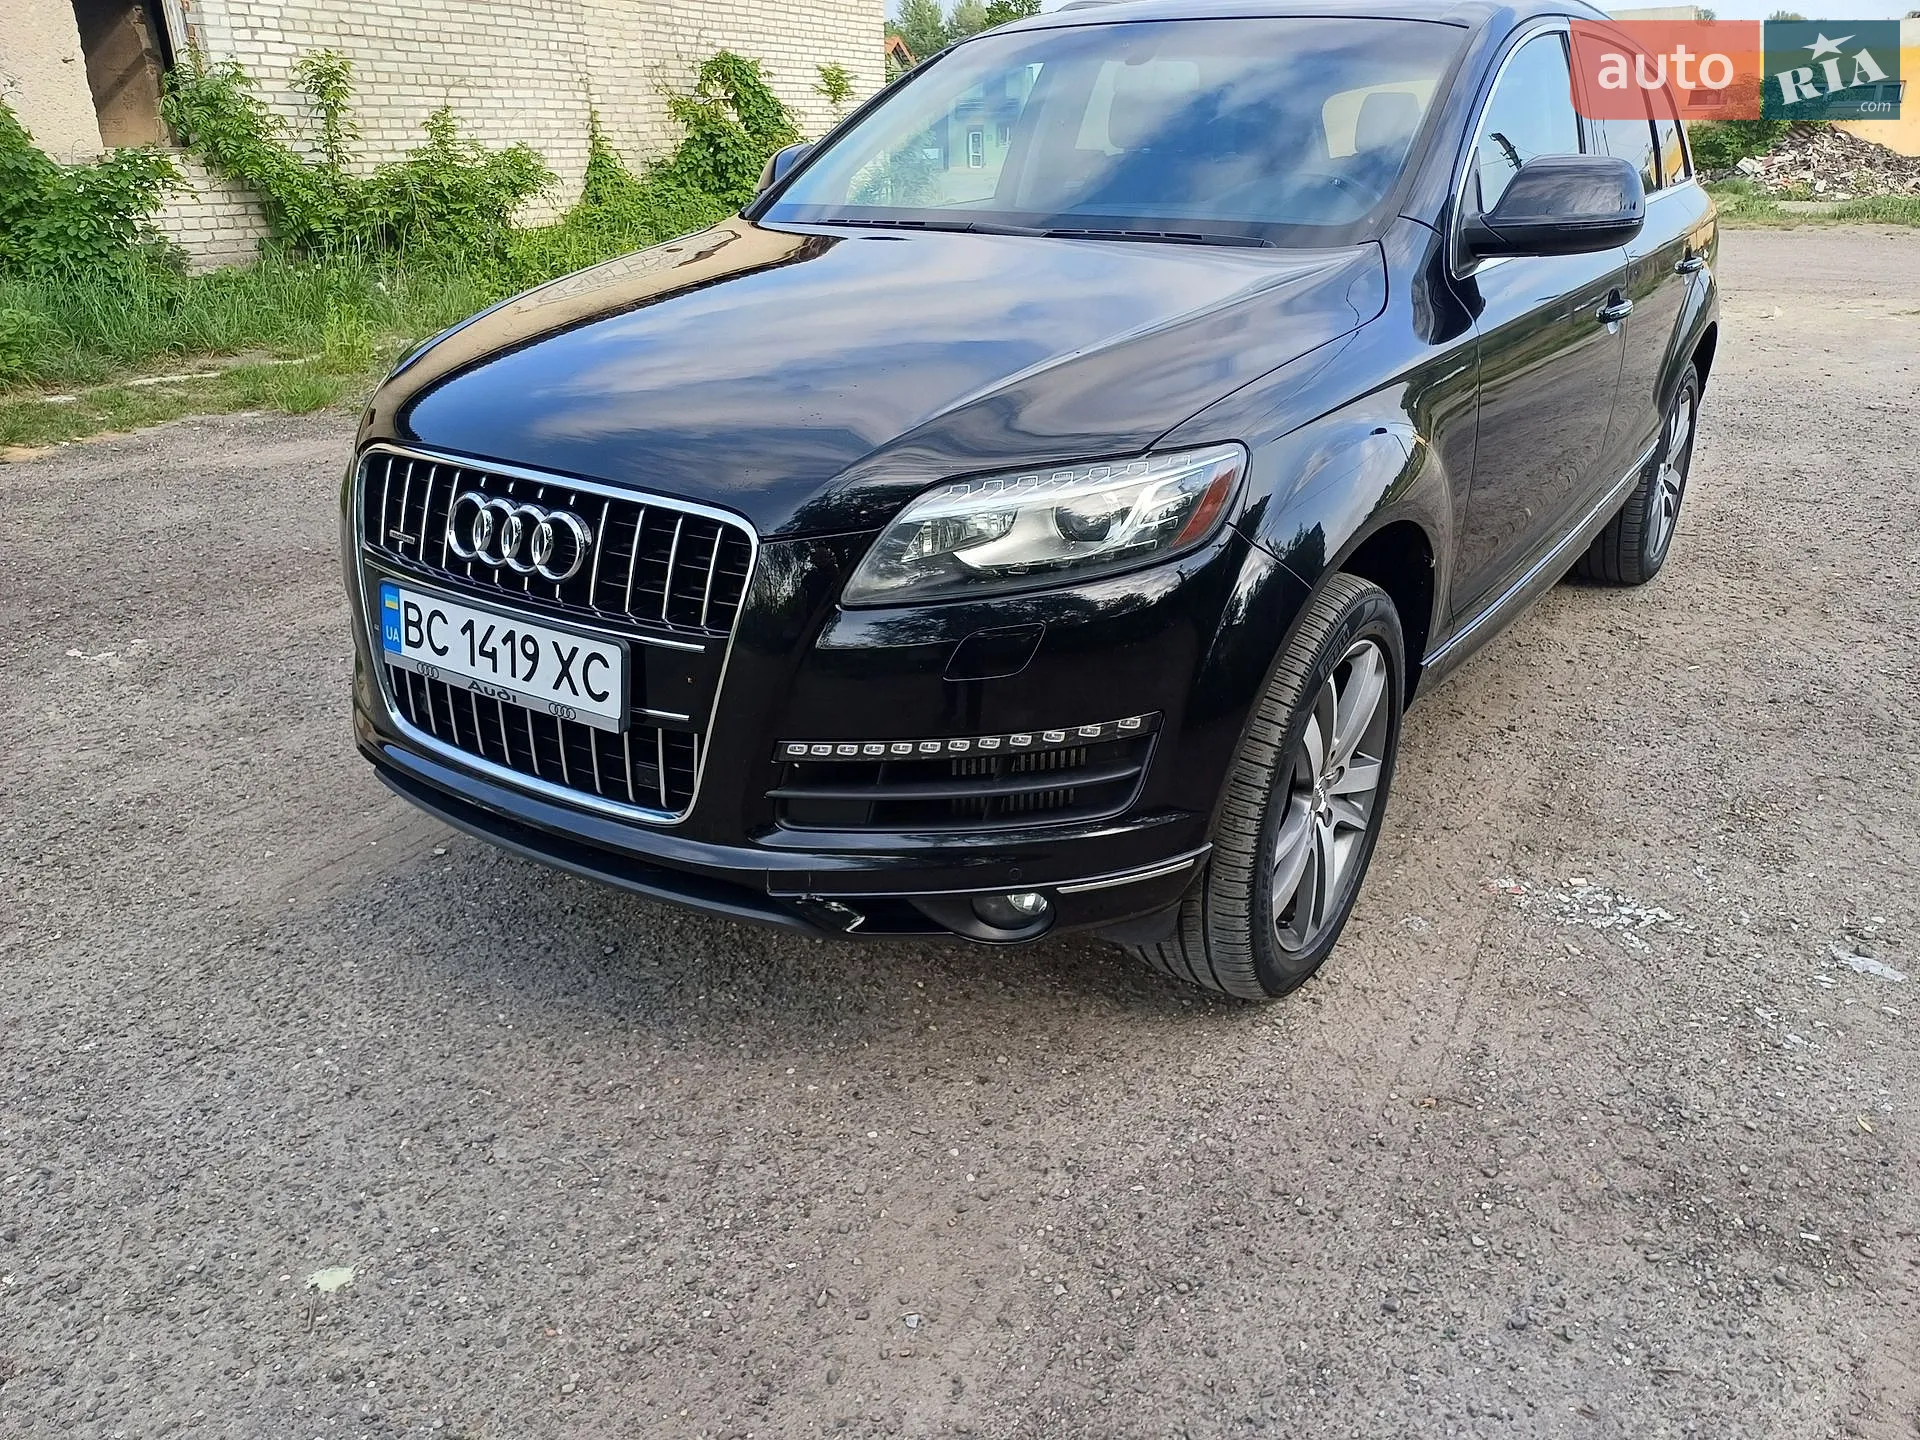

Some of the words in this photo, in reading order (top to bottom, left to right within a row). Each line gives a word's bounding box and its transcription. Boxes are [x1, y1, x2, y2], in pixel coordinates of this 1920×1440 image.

[385, 625, 400, 643] UA
[404, 600, 449, 657] BC
[460, 619, 540, 682] 1419
[552, 640, 610, 703] XC
[468, 680, 517, 703] Audi
